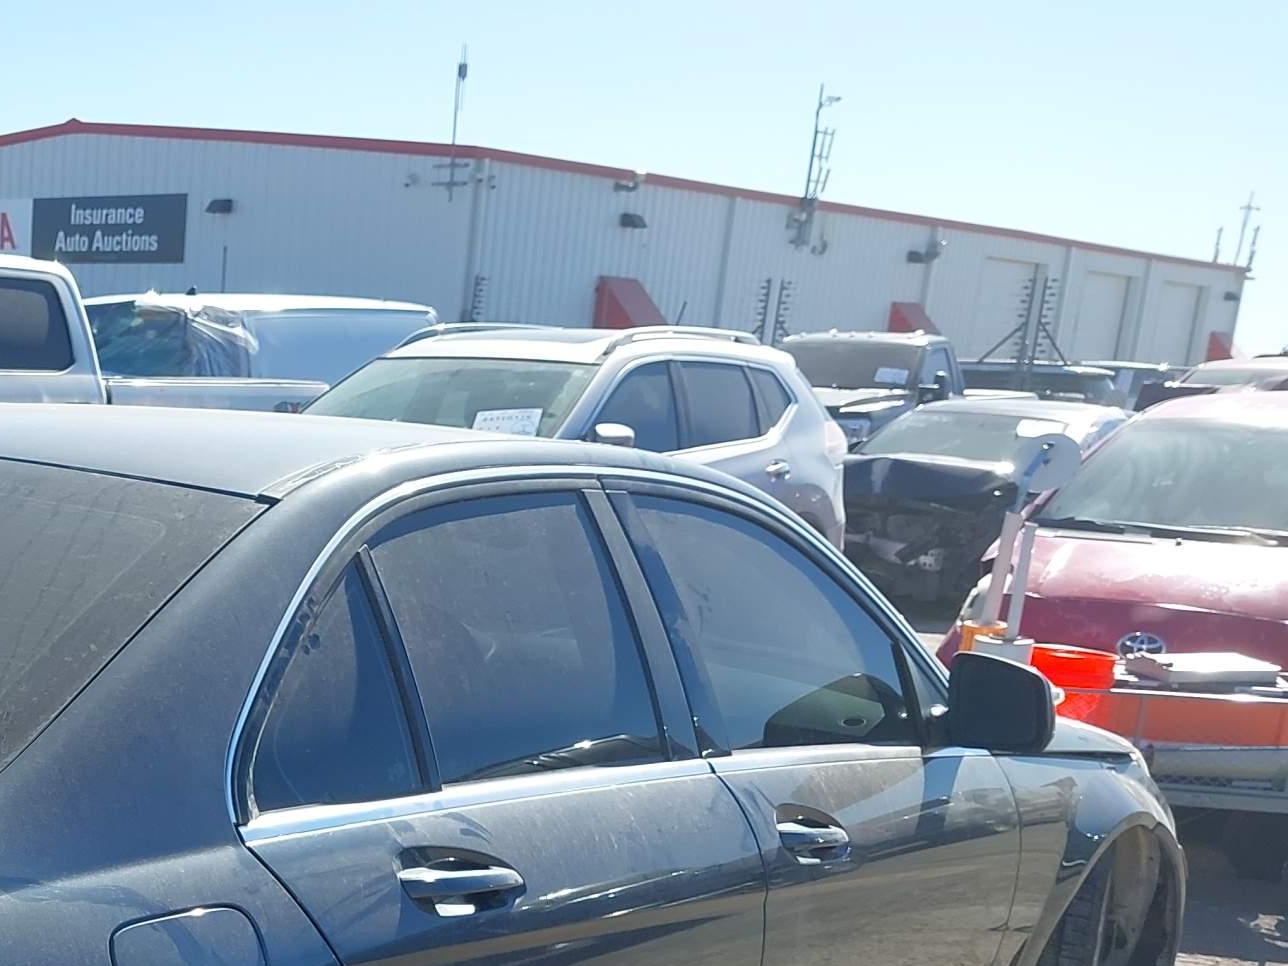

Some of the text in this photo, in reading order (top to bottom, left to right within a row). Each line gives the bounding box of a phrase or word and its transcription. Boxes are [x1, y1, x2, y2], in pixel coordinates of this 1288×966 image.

[70, 203, 145, 225] Insurance
[54, 229, 159, 252] Auto Auctions
